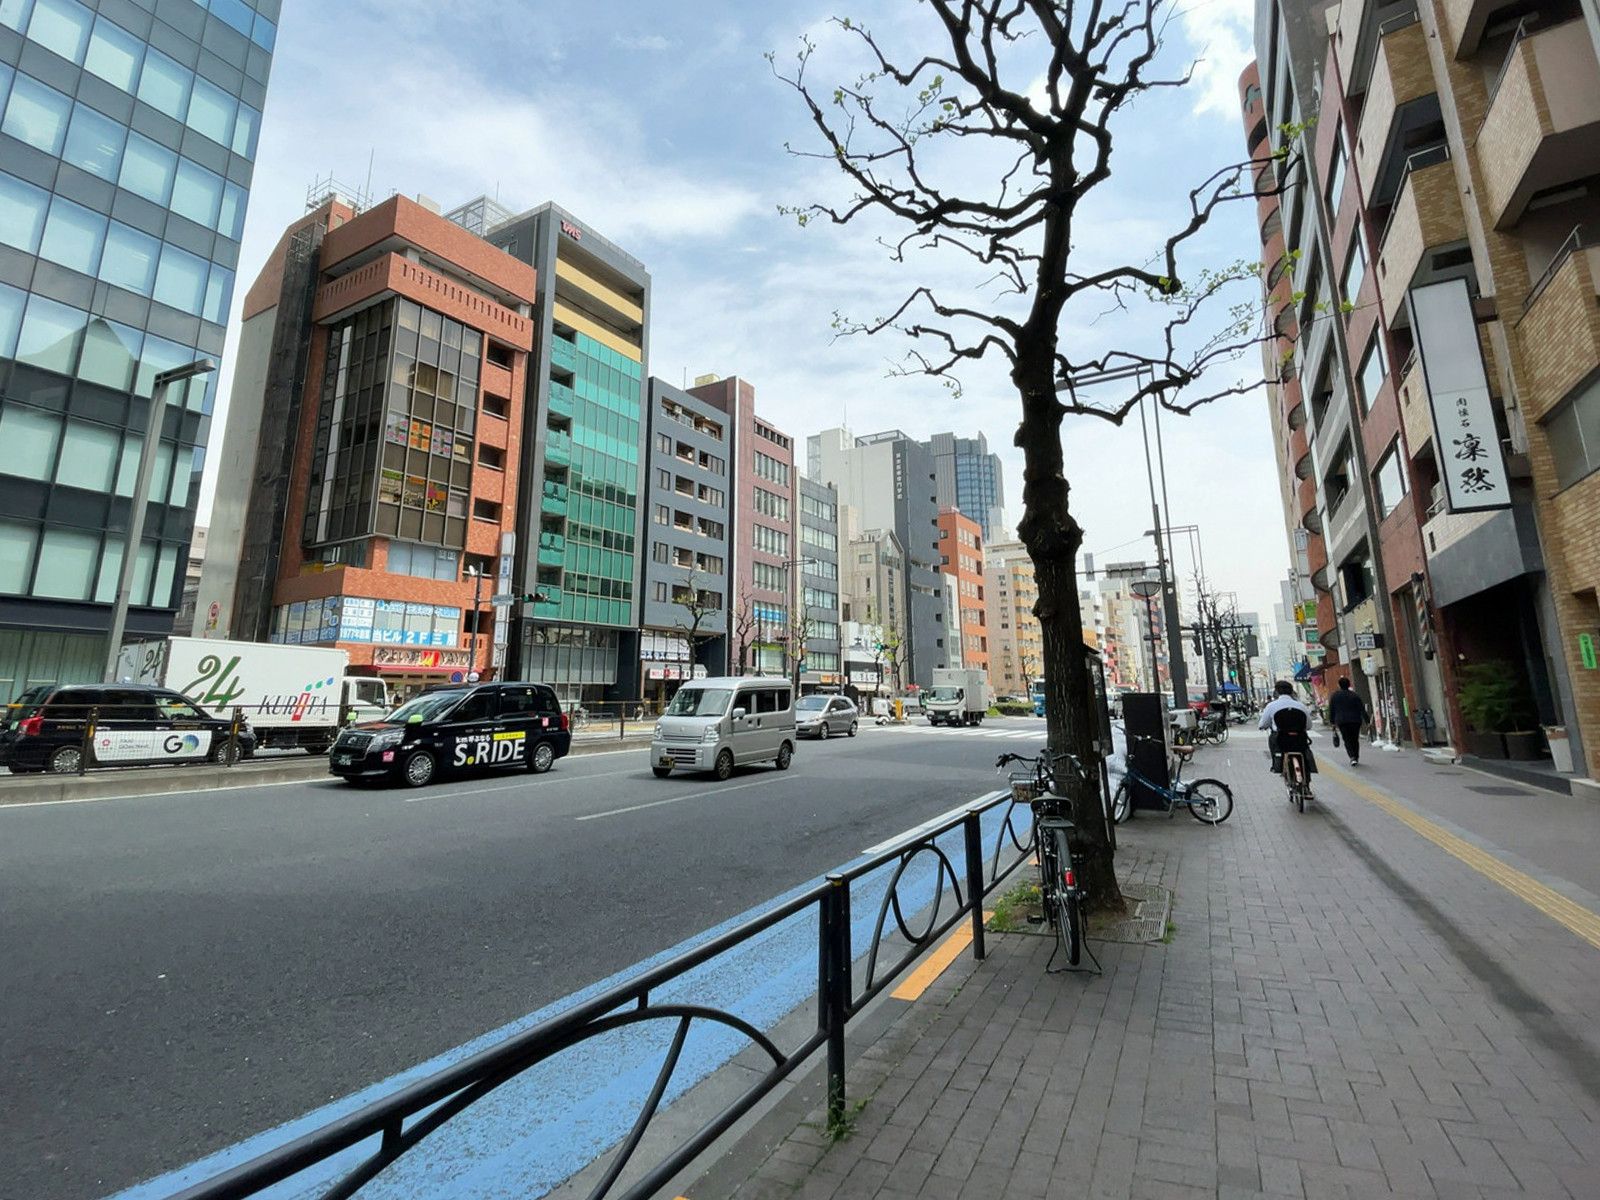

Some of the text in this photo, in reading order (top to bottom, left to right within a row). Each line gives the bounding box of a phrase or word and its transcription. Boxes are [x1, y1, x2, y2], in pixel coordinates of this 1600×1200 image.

[139, 641, 163, 678] 24
[439, 651, 474, 667] YAYO
[181, 655, 245, 713] 24
[257, 692, 329, 721] KURITA
[453, 738, 526, 767] S.RIDE
